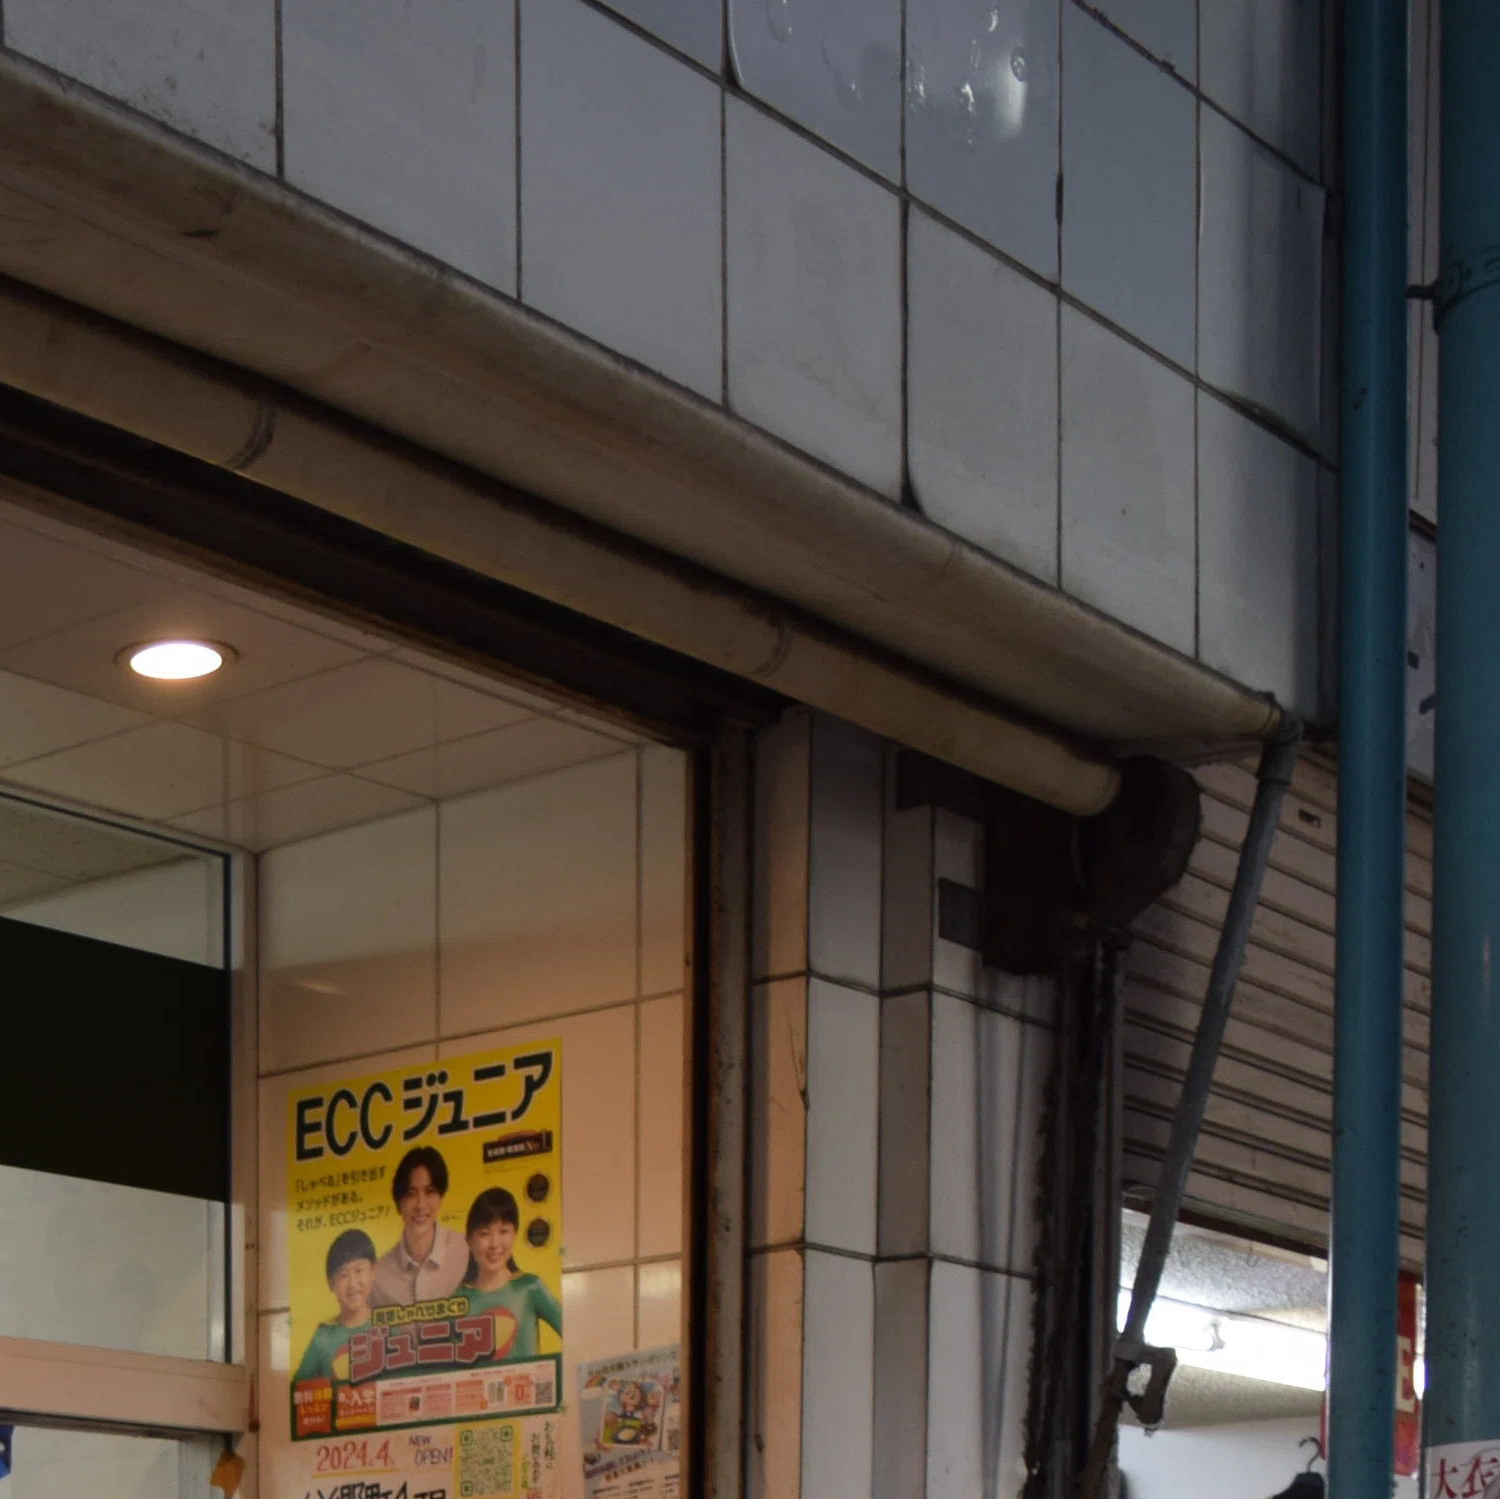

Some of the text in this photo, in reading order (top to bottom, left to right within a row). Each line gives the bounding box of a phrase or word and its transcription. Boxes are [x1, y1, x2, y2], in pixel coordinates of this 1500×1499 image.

[296, 1051, 554, 1162] ECCジュニア
[351, 1315, 495, 1382] ジュニア
[408, 1434, 432, 1446] NEW
